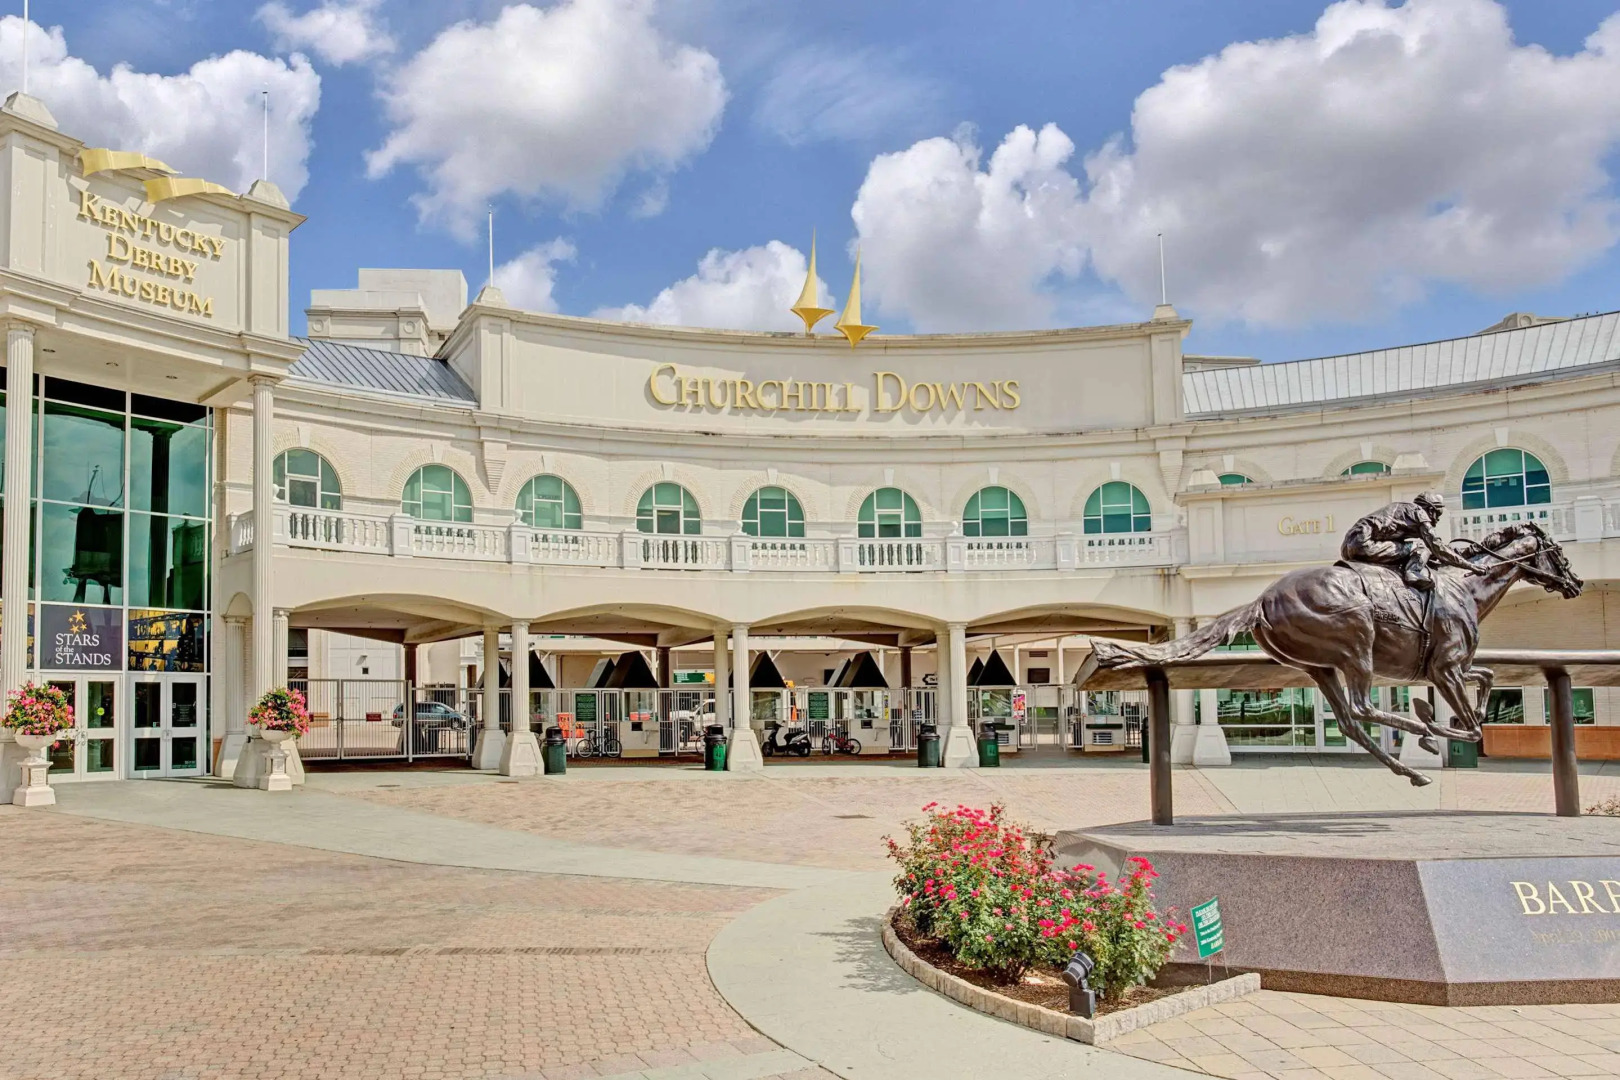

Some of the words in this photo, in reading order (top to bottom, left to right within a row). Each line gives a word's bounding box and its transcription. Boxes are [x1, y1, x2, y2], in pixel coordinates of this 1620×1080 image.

[1325, 513, 1336, 533] 1
[55, 632, 100, 647] STARS
[55, 645, 63, 653] of
[63, 645, 75, 653] the
[55, 652, 112, 666] STANDS
